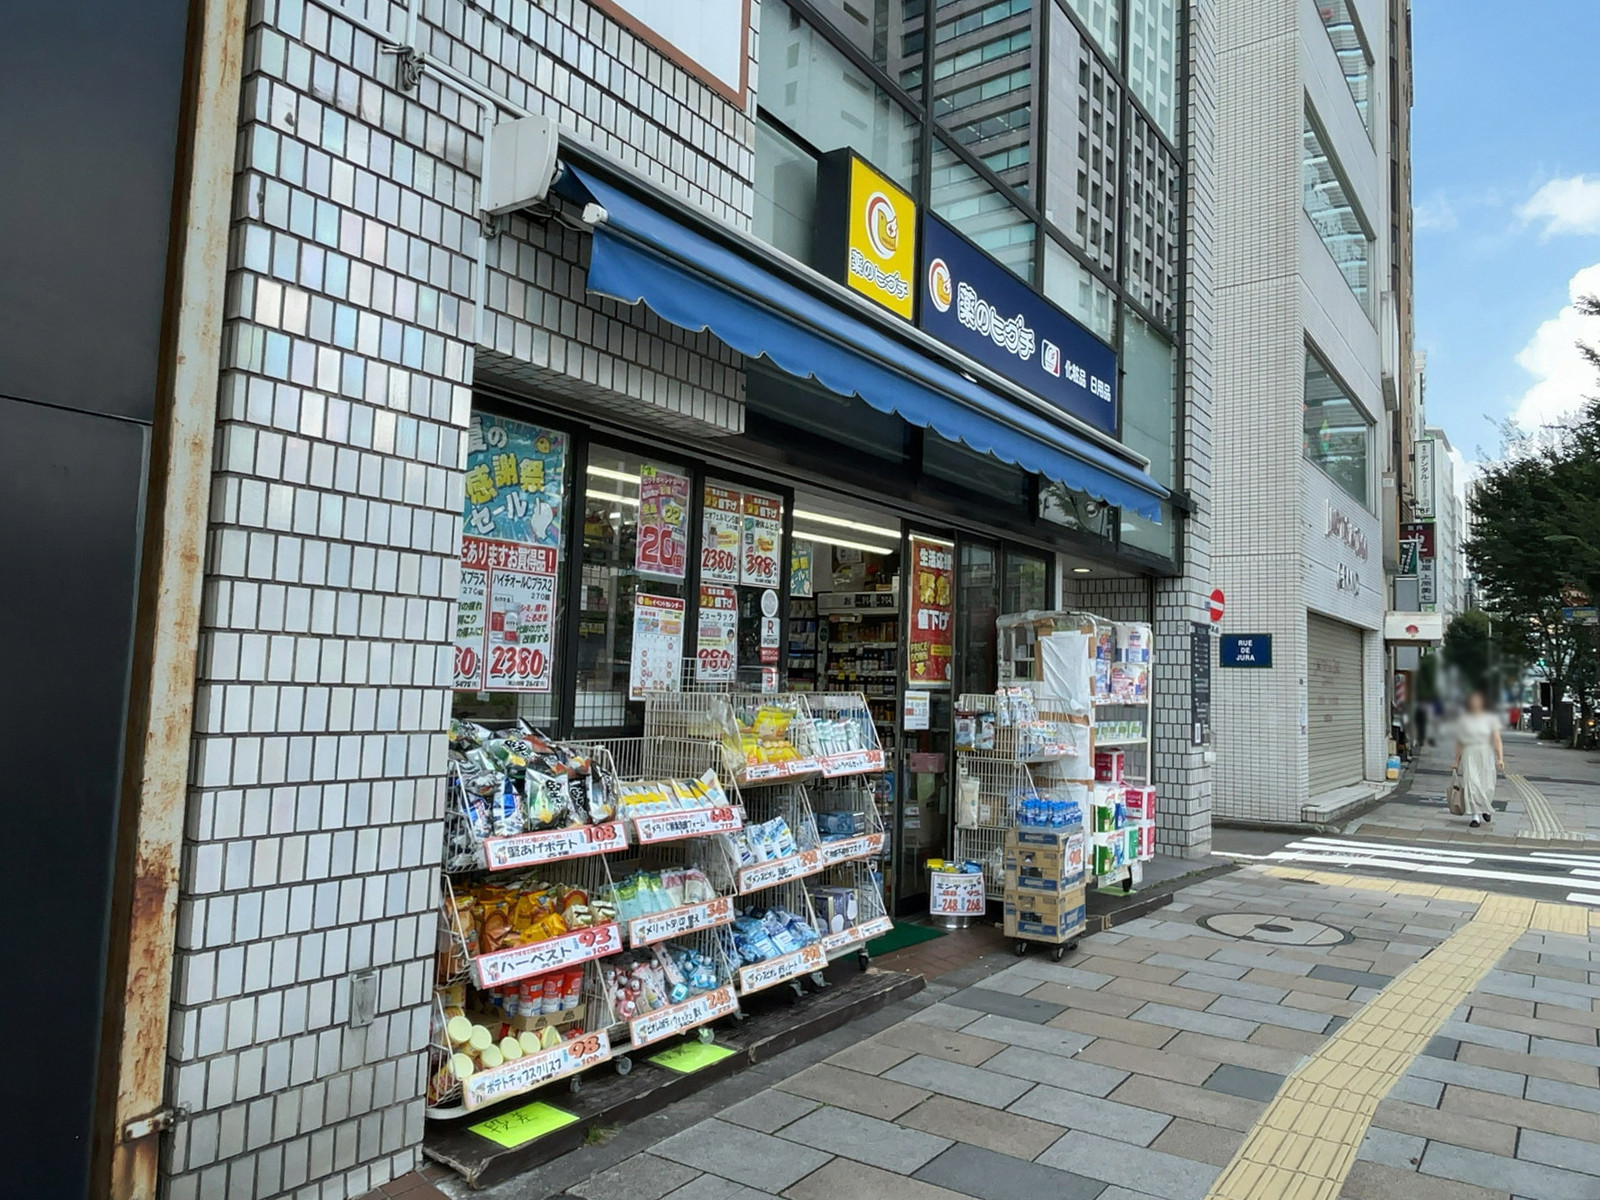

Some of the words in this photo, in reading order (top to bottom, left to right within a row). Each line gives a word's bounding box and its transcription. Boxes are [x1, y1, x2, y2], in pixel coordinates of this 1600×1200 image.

[850, 247, 909, 300] 薬のヒグチ
[957, 282, 1036, 361] 薬のヒグチ
[1064, 359, 1087, 389] 化粧品
[1090, 375, 1112, 402] 日用品
[464, 452, 545, 505] 感謝祭
[470, 491, 528, 535] セール
[917, 608, 949, 631] 値下げ
[1237, 639, 1253, 647] RUE
[490, 645, 545, 678] 2380
[1235, 654, 1256, 662] JURA
[583, 825, 617, 844] 108
[507, 838, 579, 858] 堅あげポテト
[597, 842, 615, 851] 117
[578, 927, 612, 948] 93
[500, 946, 572, 973] ハーベスト
[591, 944, 610, 955] 100
[568, 1035, 601, 1059] 98
